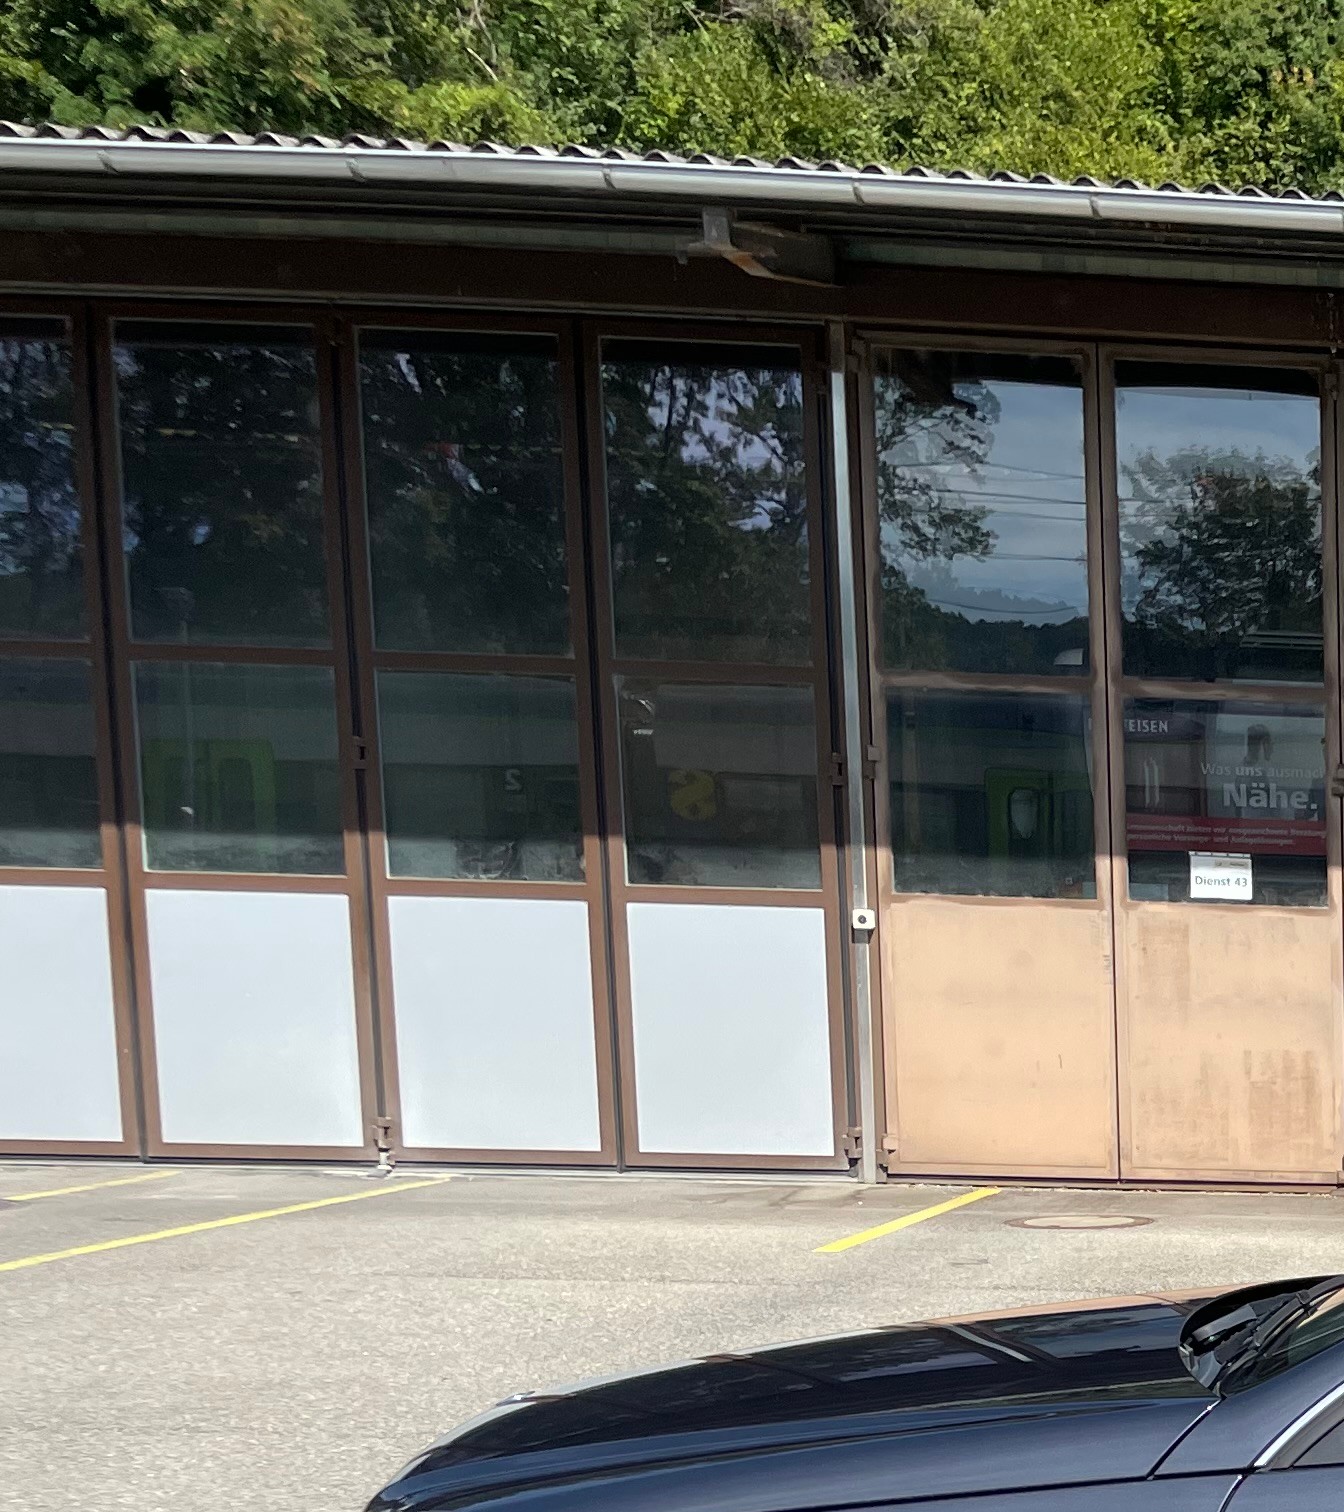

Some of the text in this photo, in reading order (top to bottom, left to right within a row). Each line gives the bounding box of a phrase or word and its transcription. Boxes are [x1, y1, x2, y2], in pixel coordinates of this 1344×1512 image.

[1123, 718, 1169, 734] EISEN
[1200, 761, 1231, 777] Was
[1235, 765, 1263, 778] uns
[1221, 782, 1319, 810] Nähe.
[1194, 875, 1249, 888] Dienst 43
